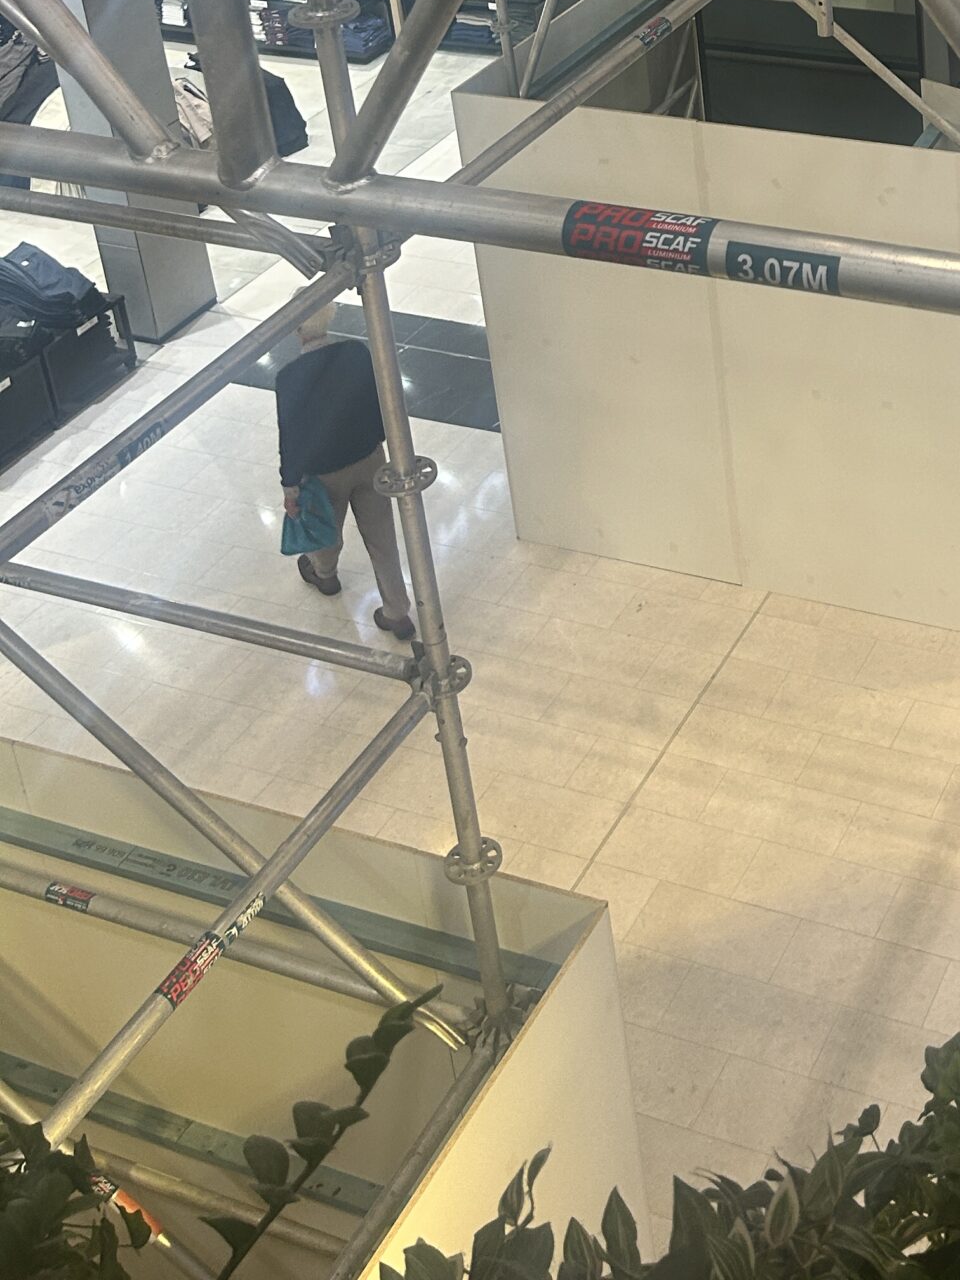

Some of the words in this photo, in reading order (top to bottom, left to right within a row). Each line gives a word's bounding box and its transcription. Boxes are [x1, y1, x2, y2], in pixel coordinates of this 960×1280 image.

[574, 201, 650, 228] PRO
[650, 211, 713, 227] SCAF
[569, 223, 644, 254] PRO
[642, 231, 702, 253] SCAF
[737, 253, 830, 292] 3.07M
